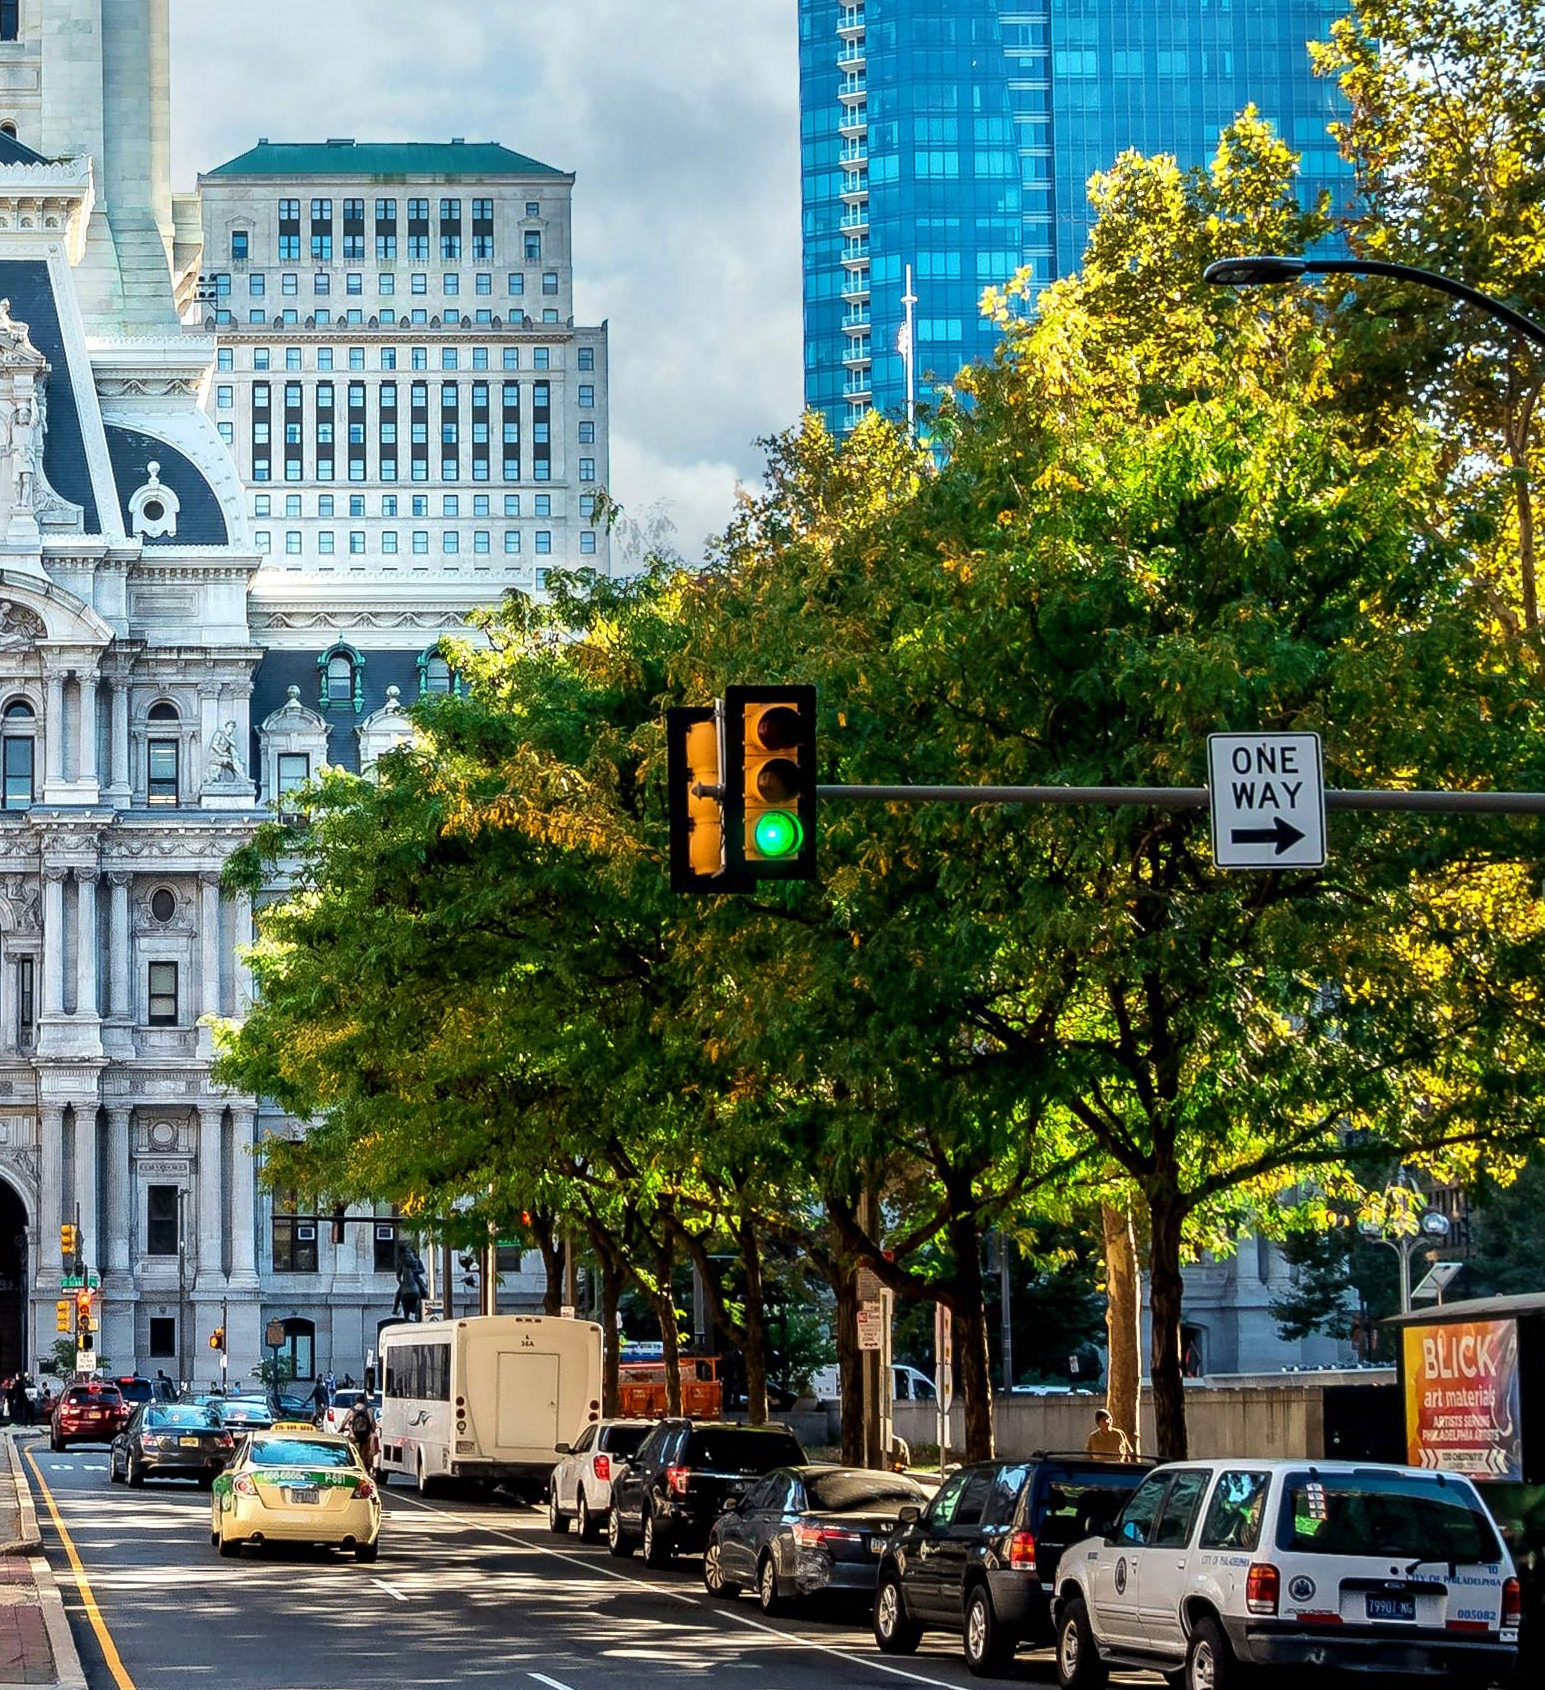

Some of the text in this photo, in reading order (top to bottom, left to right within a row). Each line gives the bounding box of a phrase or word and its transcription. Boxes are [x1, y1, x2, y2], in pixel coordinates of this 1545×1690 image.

[1232, 746, 1299, 775] ONE
[1231, 781, 1303, 809] WAY
[1422, 1334, 1497, 1380] BLICK
[1424, 1384, 1496, 1408] art materials
[1433, 1414, 1490, 1428] ARTISTS SERVING
[1422, 1428, 1500, 1442] PHILADELPHIA ARTISTS
[1405, 1573, 1501, 1586] CITY OF PHILADELPHIA
[1457, 1609, 1497, 1621] 005082
